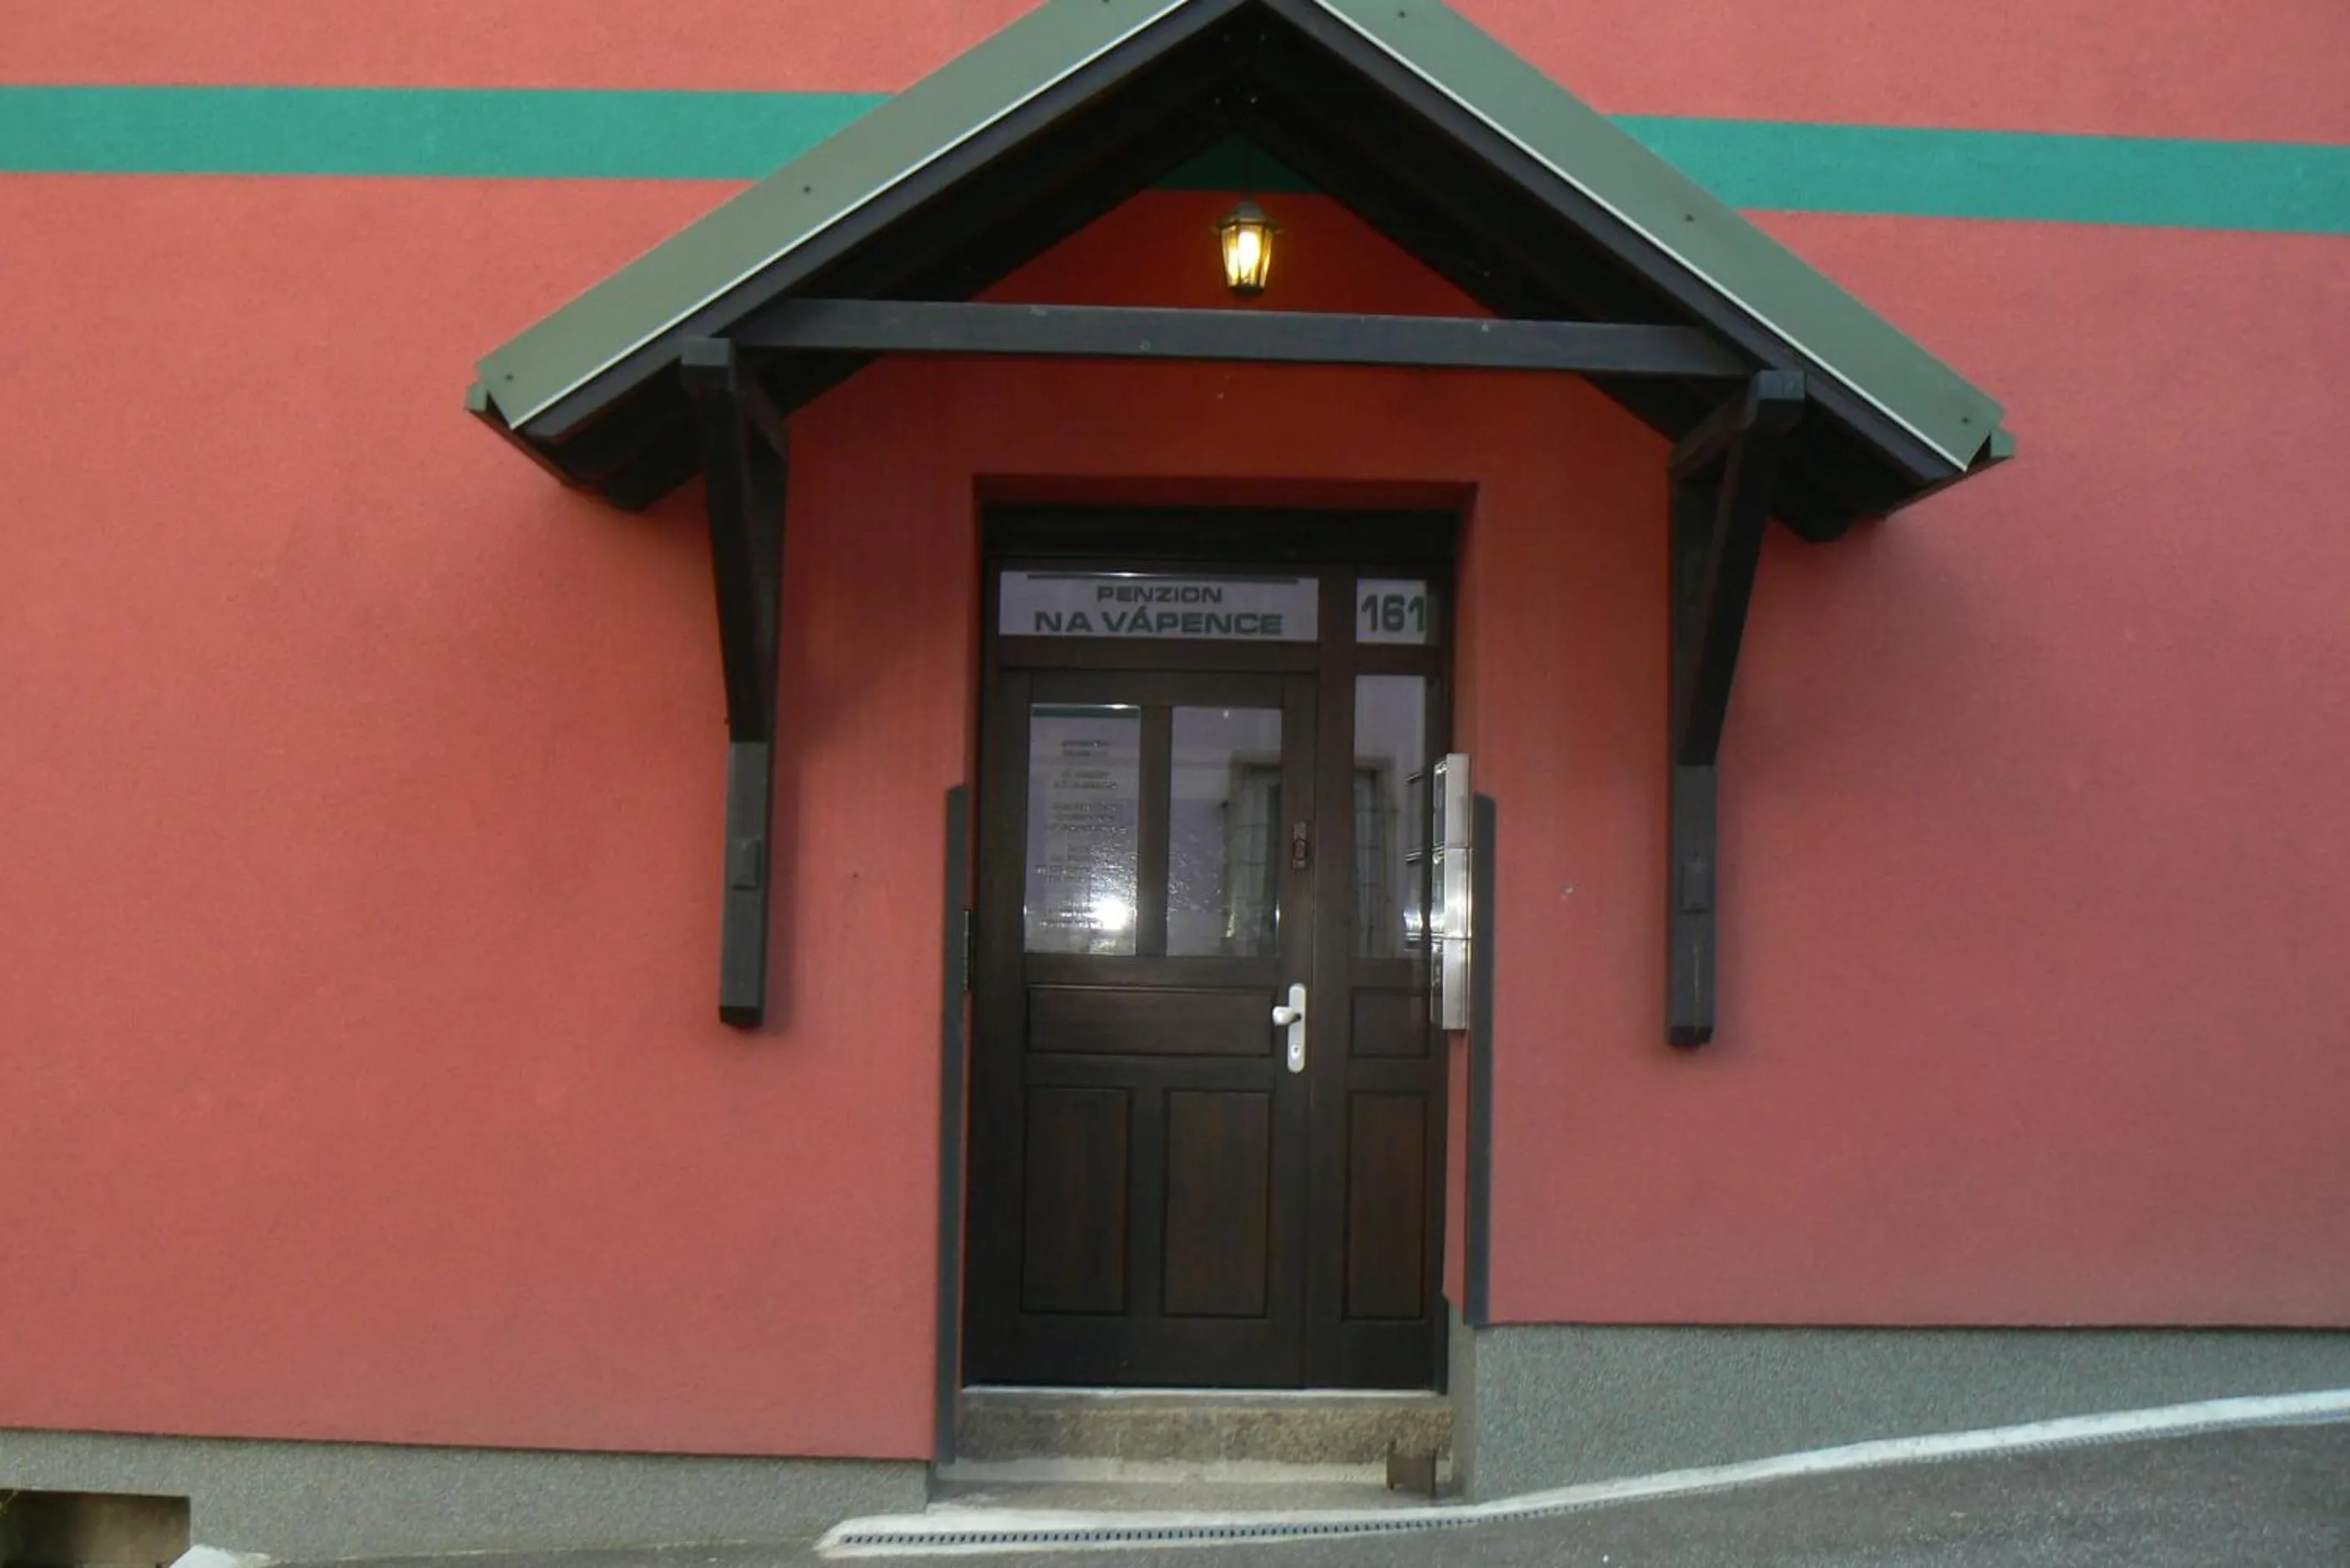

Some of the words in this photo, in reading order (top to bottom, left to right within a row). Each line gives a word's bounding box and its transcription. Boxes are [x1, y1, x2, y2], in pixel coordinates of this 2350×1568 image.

[1097, 586, 1223, 603] PENZION
[1035, 611, 1094, 633] NA
[1102, 605, 1283, 634] VÁPENCE
[1361, 593, 1425, 632] 161
